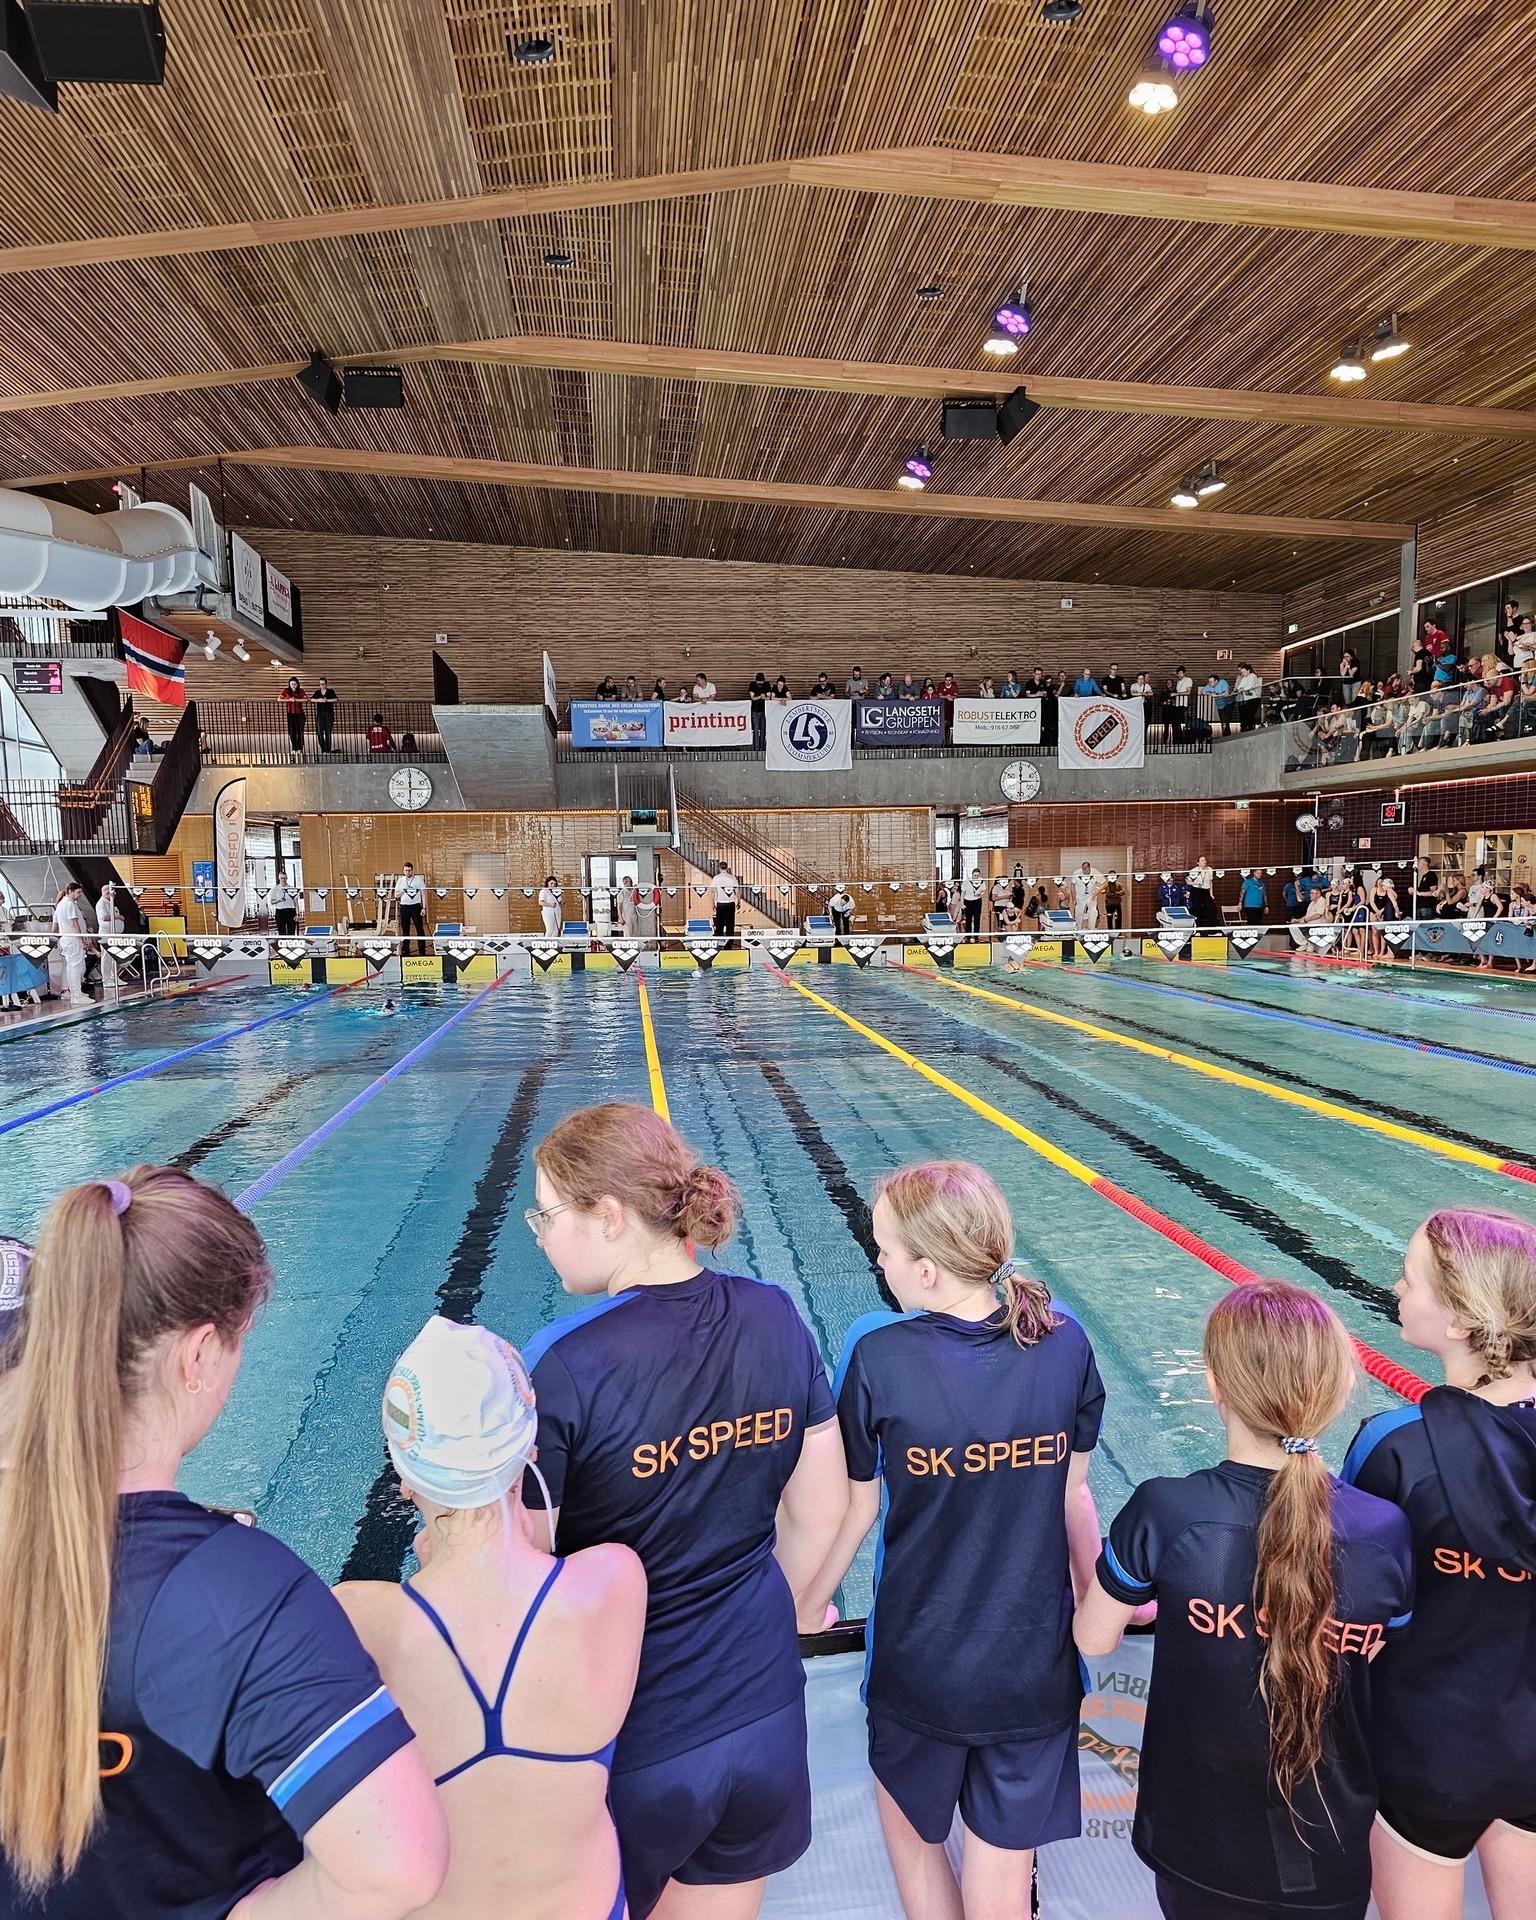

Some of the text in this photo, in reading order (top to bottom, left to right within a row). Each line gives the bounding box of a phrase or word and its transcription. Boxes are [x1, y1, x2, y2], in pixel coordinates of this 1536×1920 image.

[786, 705, 832, 724] LAMBERTSETER
[886, 706, 940, 716] LANGSETH
[958, 710, 1037, 720] ROBUSTELEKTRO
[669, 712, 747, 732] printing
[886, 717, 940, 728] GRUPPEN
[1087, 716, 1116, 748] SPEED
[228, 832, 239, 878] SPEED
[1384, 924, 1409, 933] arena
[1463, 921, 1486, 930] arena
[1158, 931, 1184, 940] arena
[1232, 929, 1258, 938] arena
[1309, 927, 1334, 936] arena
[20, 936, 49, 945] arena
[108, 938, 136, 946] arena
[850, 938, 875, 946] arena
[928, 937, 953, 945] arena
[1006, 935, 1032, 944] arena
[1084, 933, 1109, 942] arena
[193, 938, 222, 947] arena
[278, 939, 306, 948] arena
[364, 940, 391, 949] arena
[448, 940, 475, 949] arena
[531, 940, 558, 949] arena
[612, 940, 638, 949] arena
[692, 940, 718, 948] arena
[770, 939, 795, 948] arena
[4, 1252, 19, 1295] SPEED
[632, 1408, 793, 1478] SK SPEED
[906, 1431, 1067, 1477] SK SPEED
[1434, 1548, 1486, 1579] SK
[1188, 1598, 1245, 1639] SK
